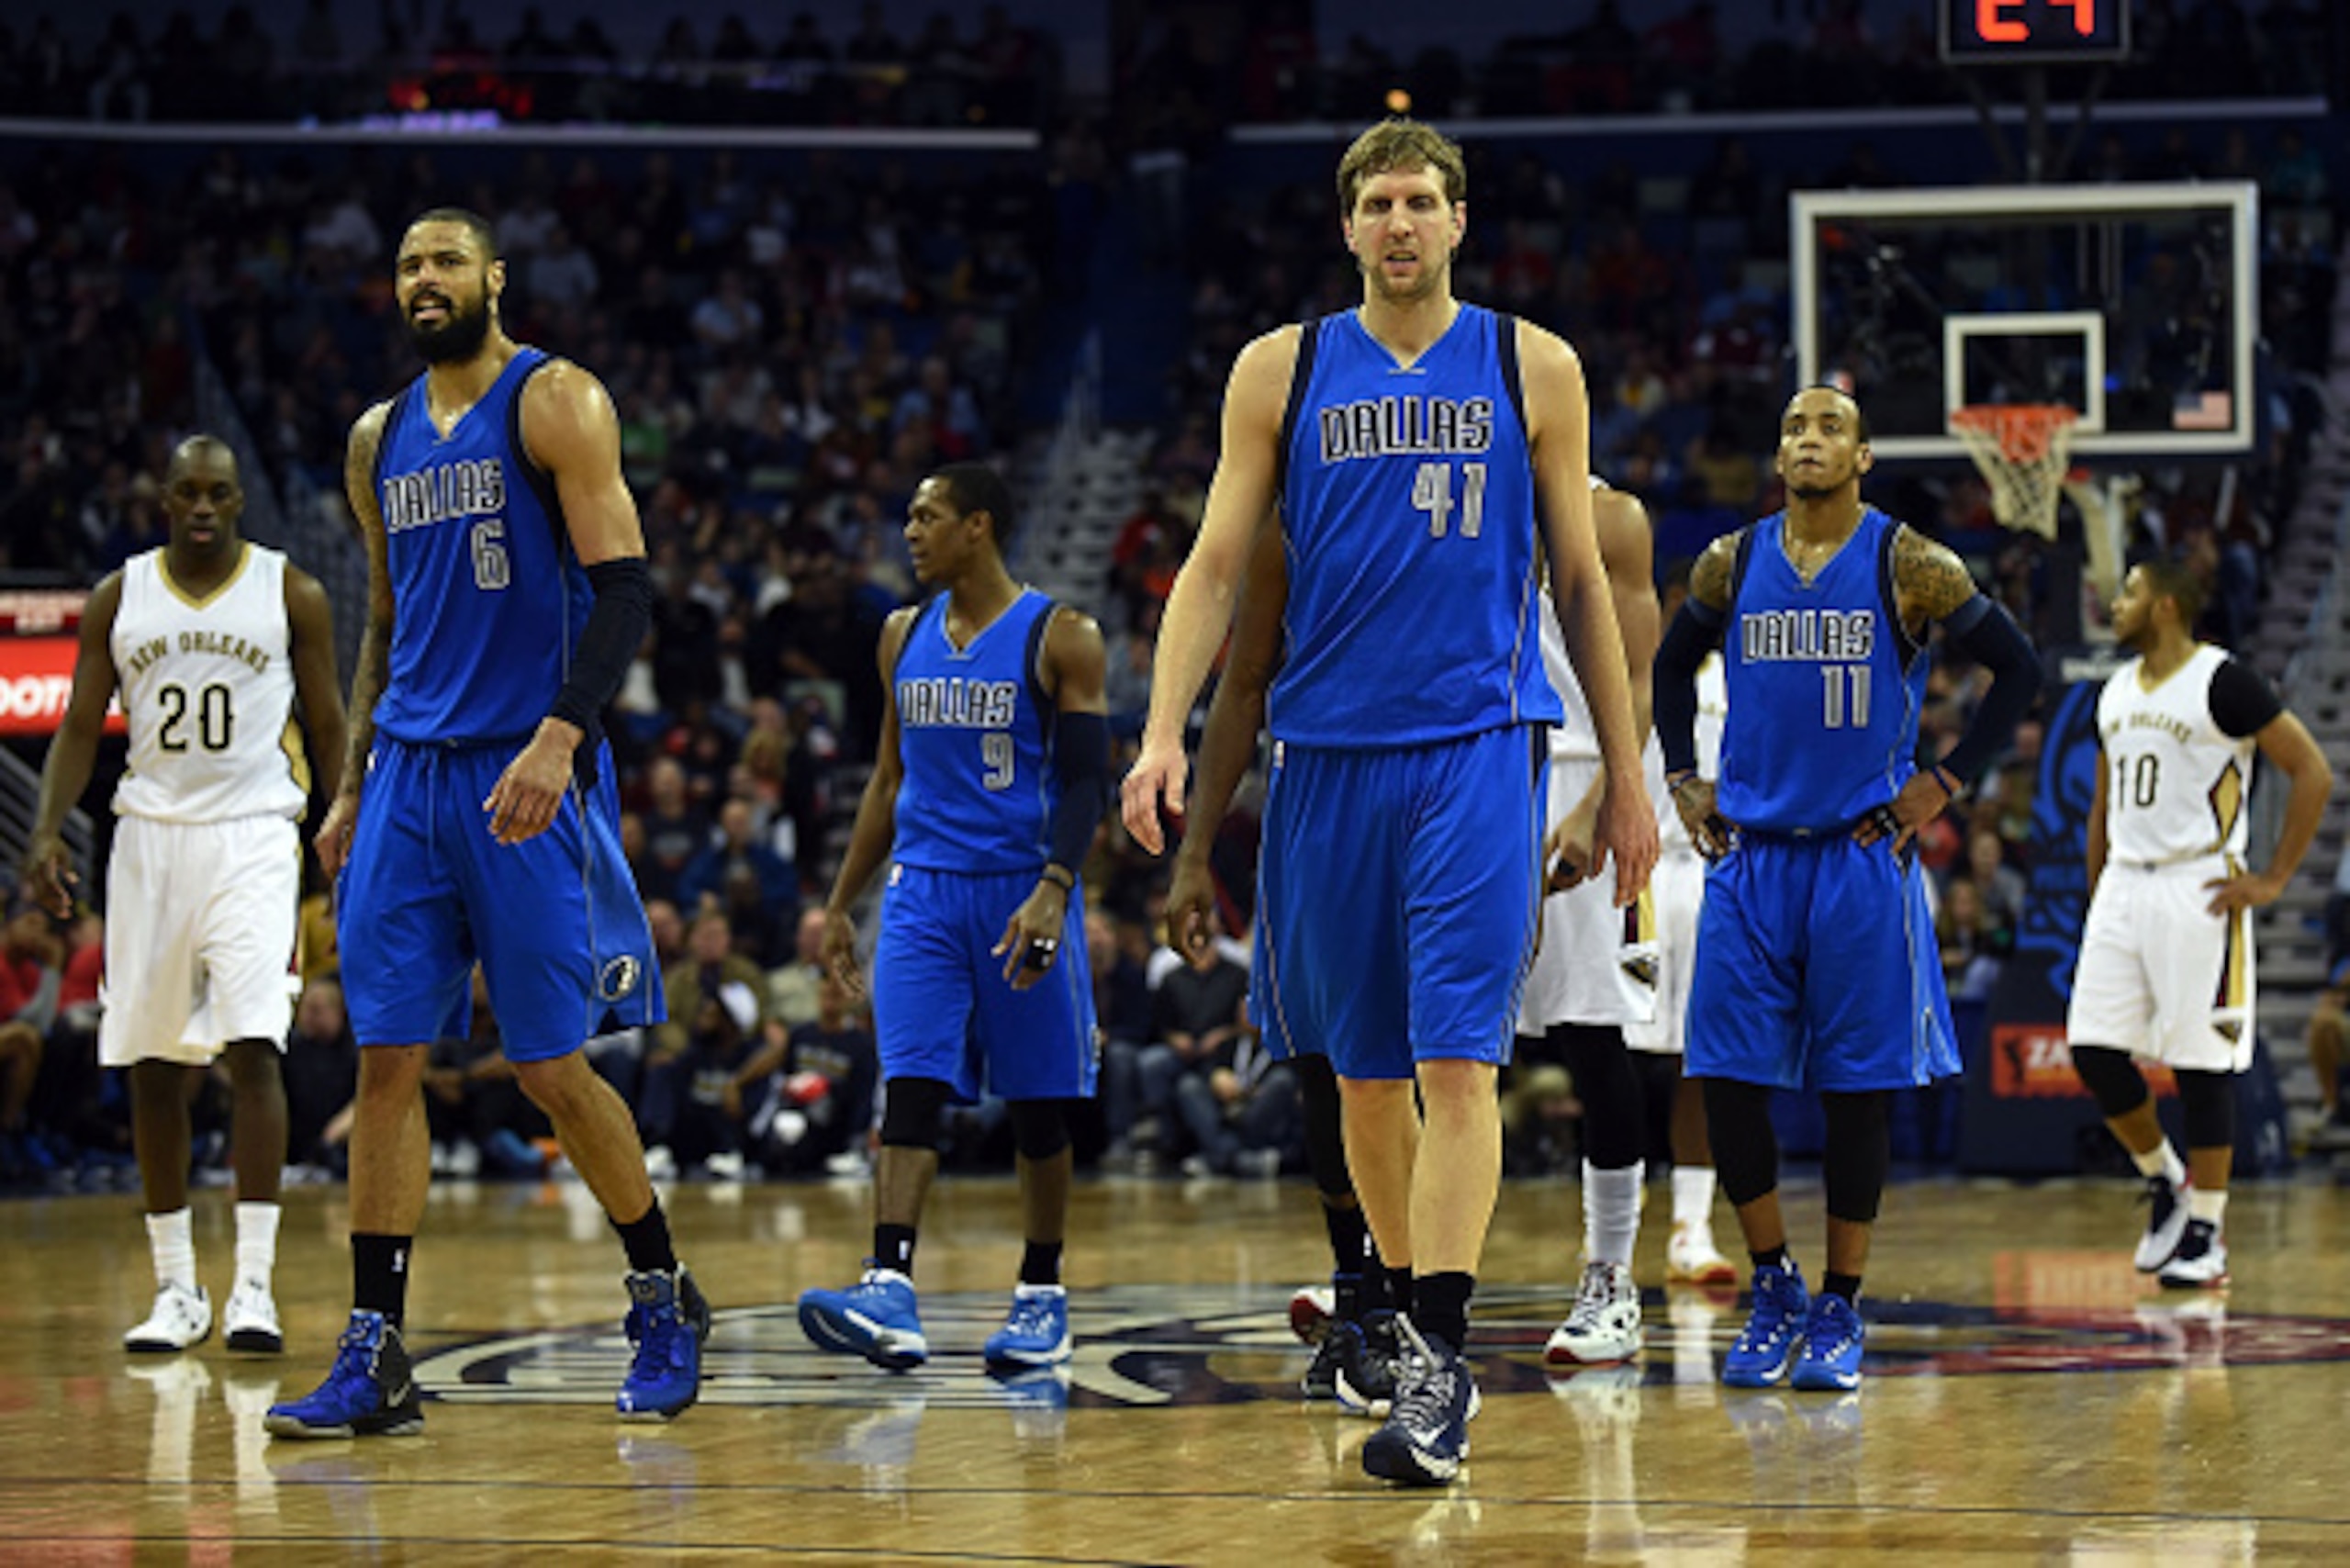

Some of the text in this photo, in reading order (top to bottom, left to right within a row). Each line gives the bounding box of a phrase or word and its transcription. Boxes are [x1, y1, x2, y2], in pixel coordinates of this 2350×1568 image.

[1319, 396, 1494, 465] DALLAS
[383, 458, 506, 534] DALLAS
[1411, 462, 1487, 539] 41
[470, 518, 510, 590] 6
[129, 631, 271, 675] NEW ORLEANS
[1740, 609, 1874, 666] DALLAS
[158, 682, 234, 753] 20
[898, 678, 1018, 729] DALLAS
[1820, 665, 1872, 729] 11
[980, 733, 1015, 792] 9
[2116, 752, 2160, 812] 10
